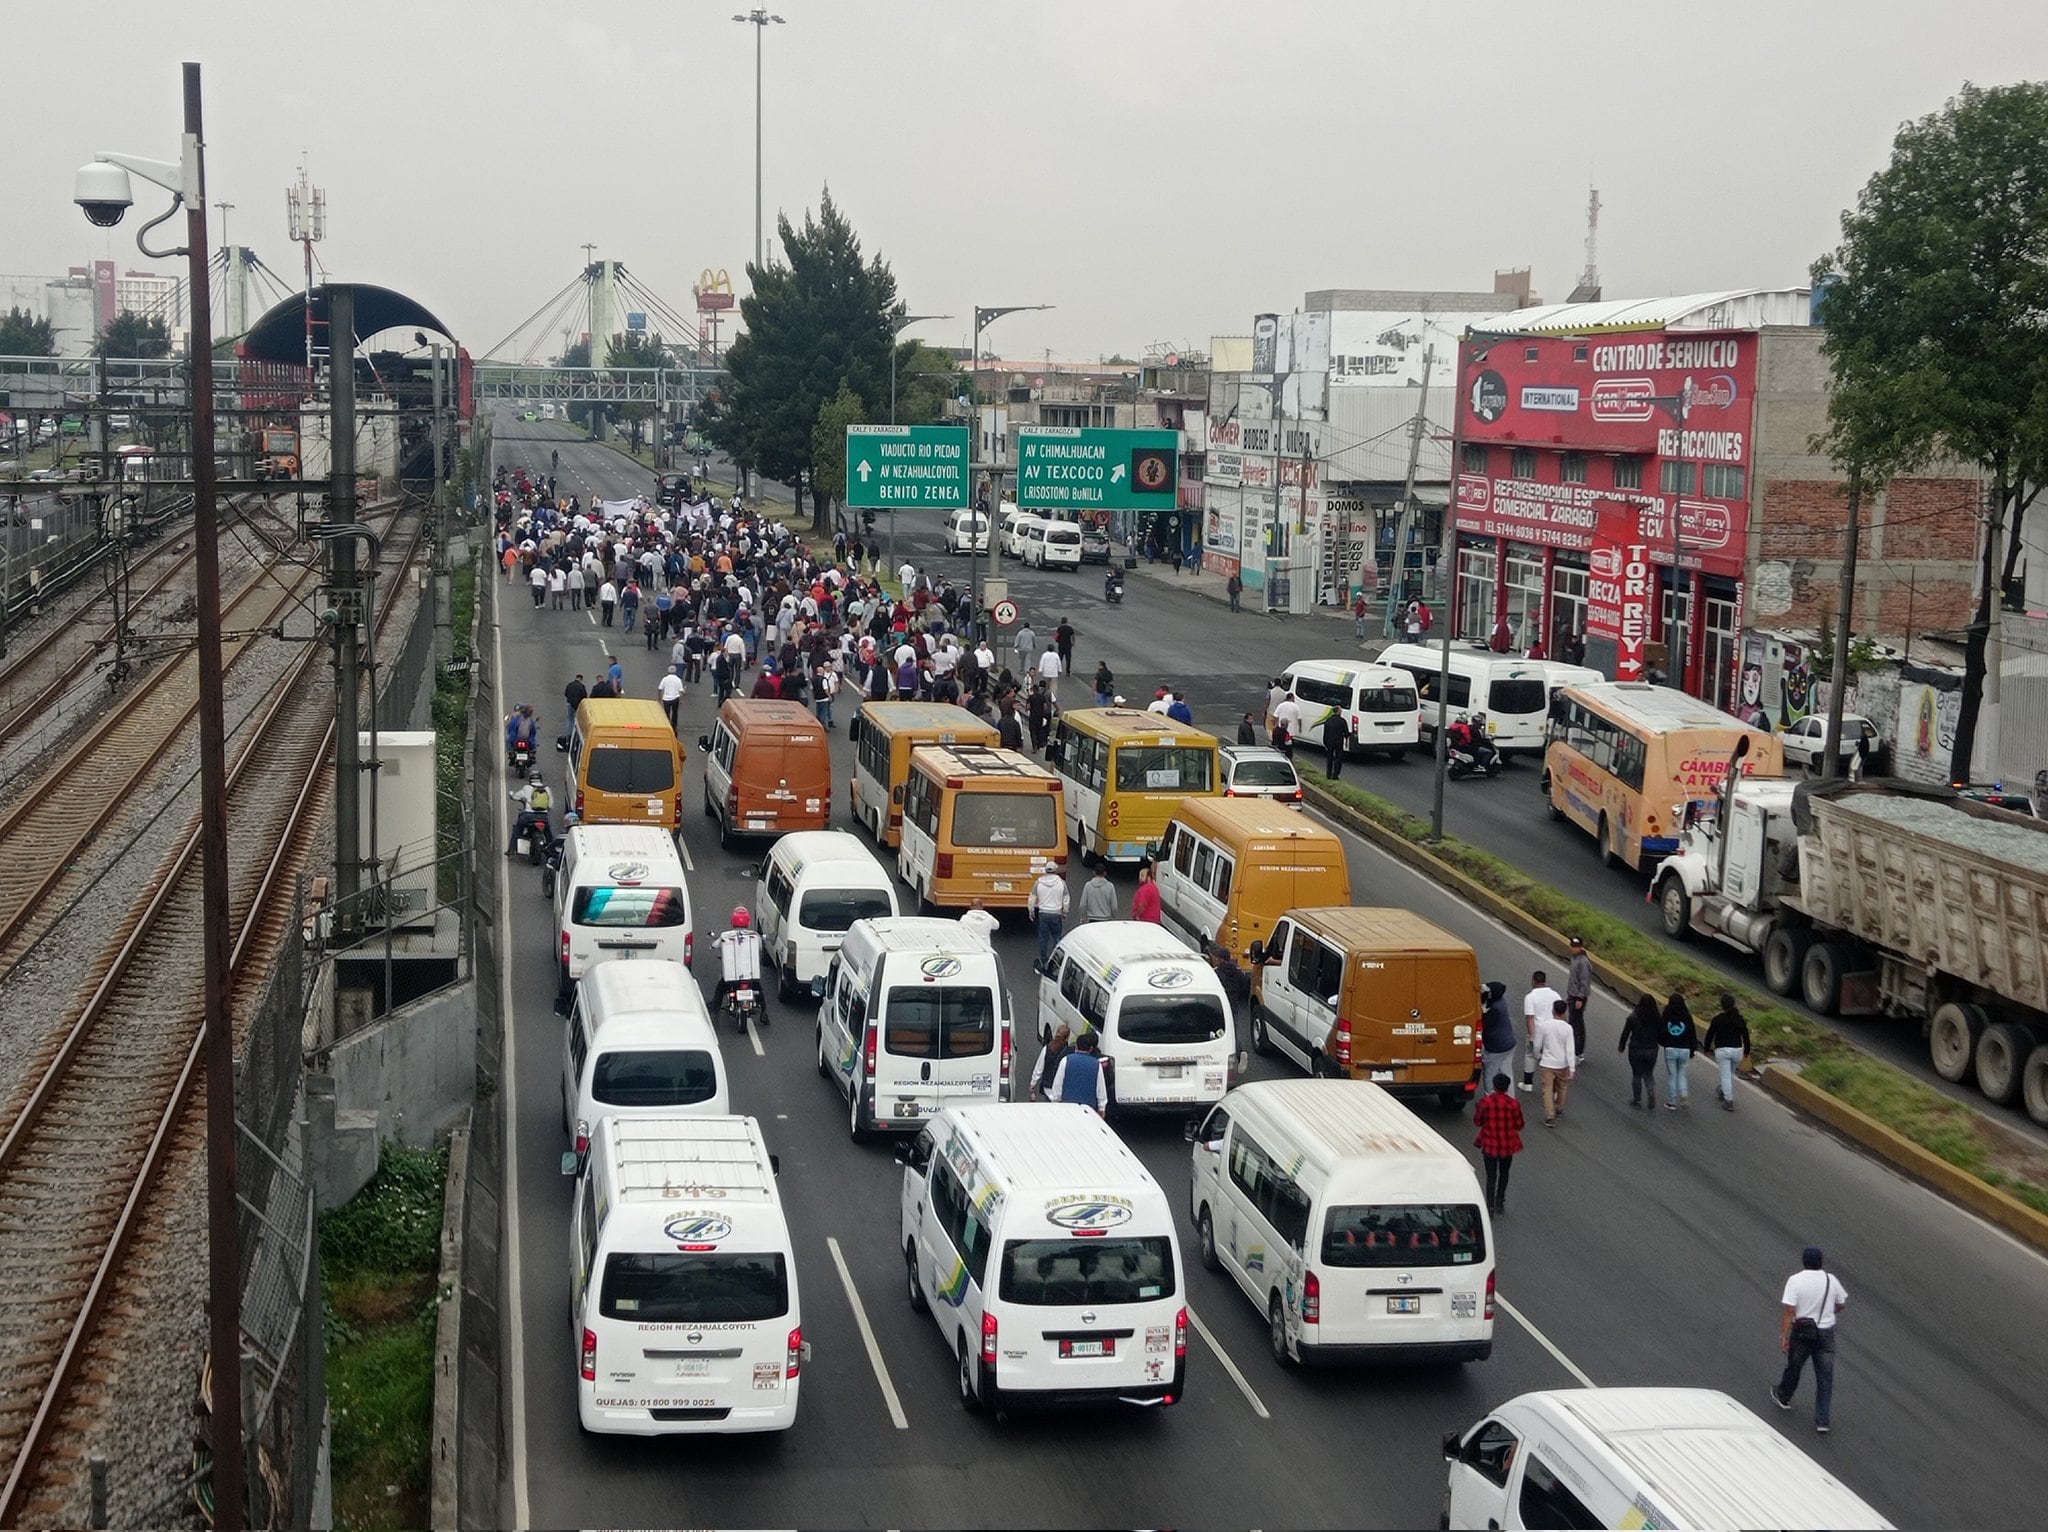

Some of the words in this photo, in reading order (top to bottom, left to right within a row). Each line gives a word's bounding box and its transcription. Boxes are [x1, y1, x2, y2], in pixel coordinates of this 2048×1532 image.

[1592, 344, 1645, 372] CENTRO
[1646, 346, 1665, 370] DE
[1665, 340, 1738, 369] SERVICIO
[1523, 390, 1577, 407] INTERNATIONAL
[1243, 428, 1269, 451] BODEGA
[1657, 428, 1743, 461] REFACCIONES
[880, 443, 916, 457] VIADUCTO
[918, 444, 932, 458] RIO
[1025, 444, 1037, 457] AV
[1040, 445, 1105, 459] CHIMALHUACAN
[880, 465, 889, 478] AV
[893, 465, 960, 479] NEZAHUALCOYOTL
[1025, 465, 1041, 479] AV
[1046, 465, 1104, 480] TEXCOCO
[880, 485, 918, 499] BENITO
[924, 486, 960, 500] ZENEA
[1327, 500, 1365, 512] DOMOS
[1493, 497, 1549, 521] COMERCIAL
[1550, 505, 1597, 528] ZARAGO
[1542, 529, 1561, 544] 5744
[1588, 579, 1621, 606] RECZA
[1732, 582, 1744, 661] ESTUFAS
[1680, 757, 1755, 775] CÁMBITE
[1687, 774, 1696, 786] A
[675, 1323, 757, 1331] NEZAHUALCOYOTL
[692, 1399, 716, 1407] 0025
